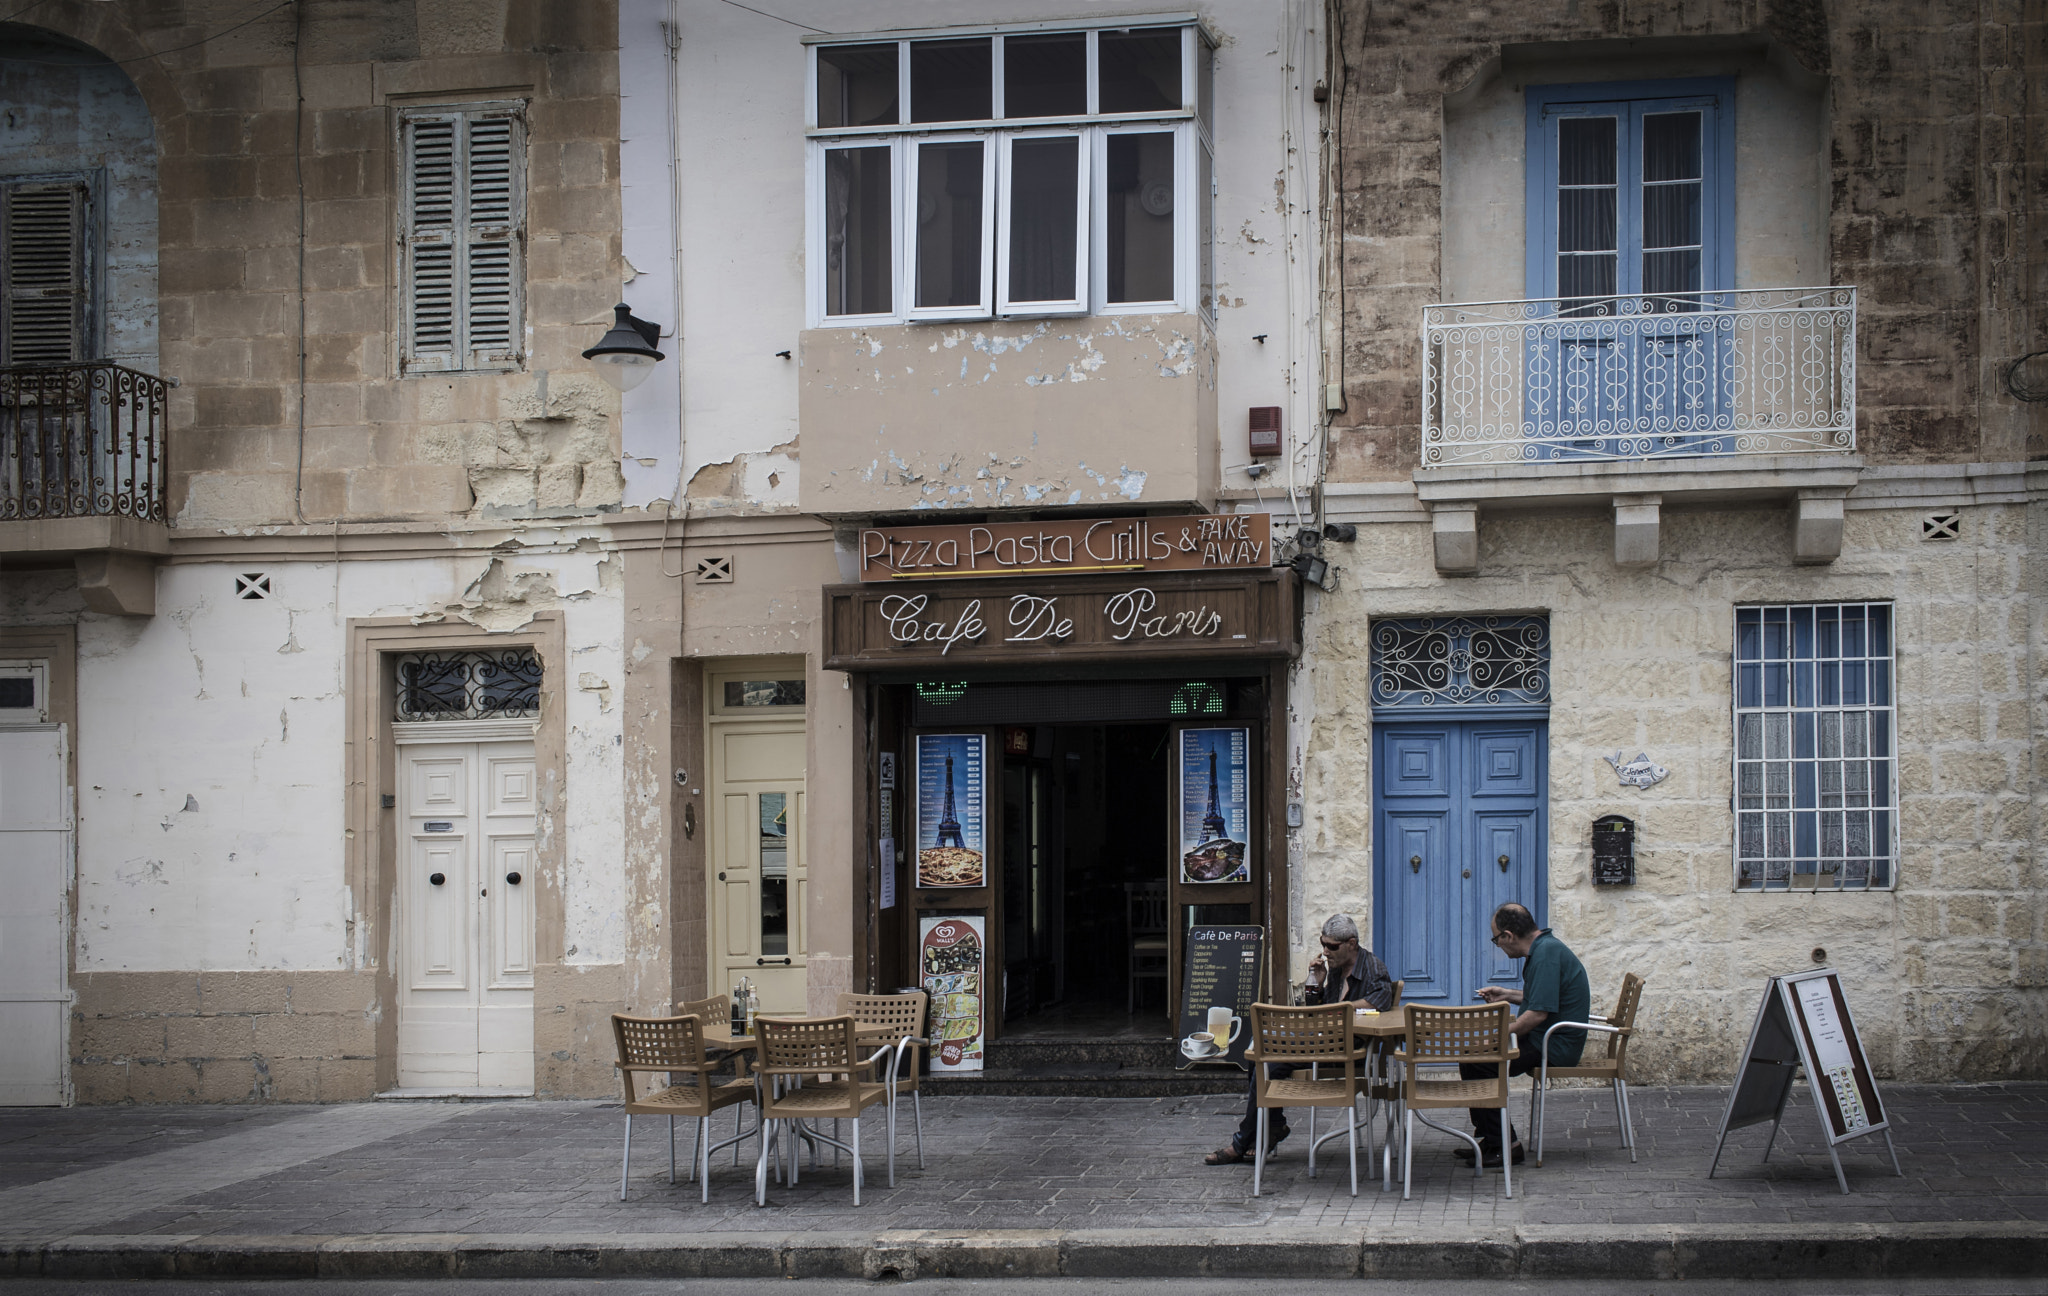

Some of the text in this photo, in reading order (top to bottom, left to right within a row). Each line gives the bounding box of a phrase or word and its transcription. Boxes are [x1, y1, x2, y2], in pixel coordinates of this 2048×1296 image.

[1198, 516, 1250, 541] TAKE
[863, 520, 1198, 571] Pizza Pasta Grills &
[1203, 540, 1263, 565] AWAY
[880, 588, 1222, 656] Cafe De Paris
[1218, 931, 1231, 940] De
[1234, 931, 1258, 940] Paris
